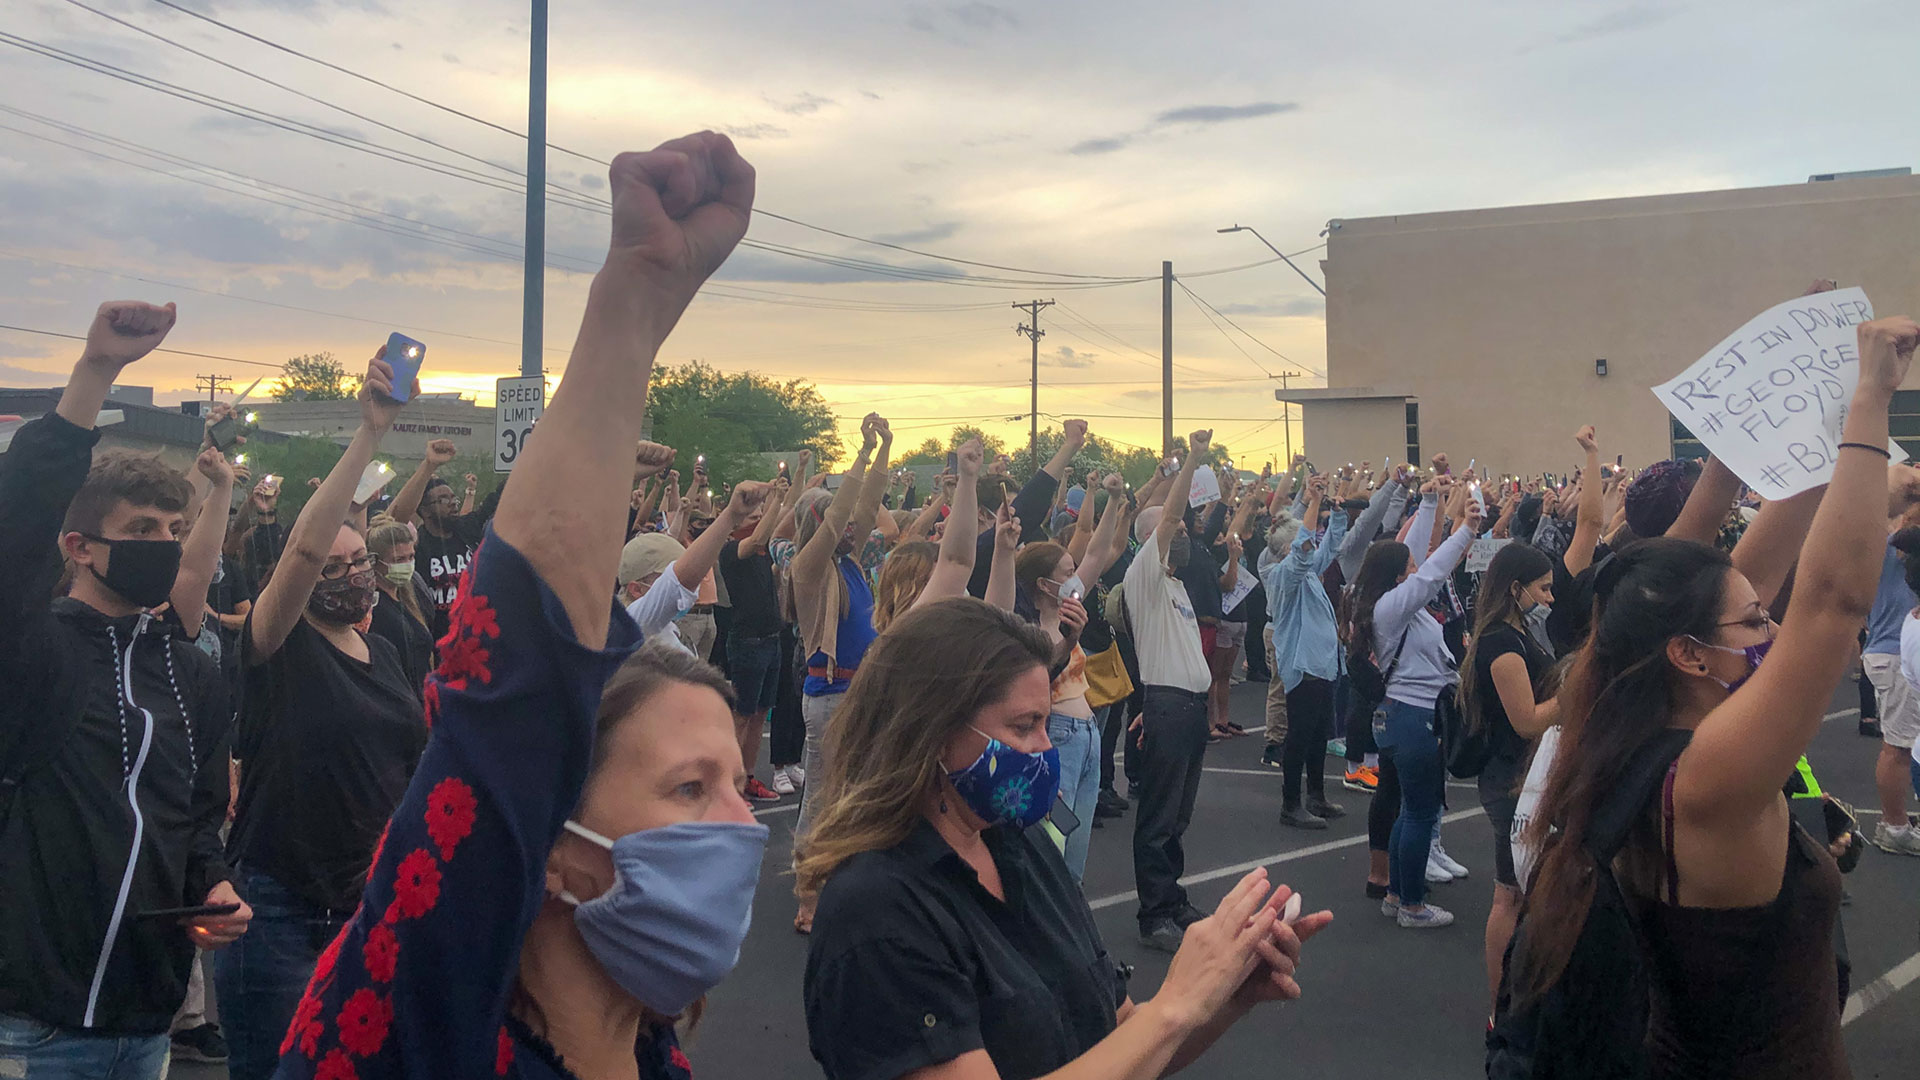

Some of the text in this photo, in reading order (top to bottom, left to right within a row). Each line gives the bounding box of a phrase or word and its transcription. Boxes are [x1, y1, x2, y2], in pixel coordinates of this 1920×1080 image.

[1671, 300, 1873, 411] REST IN POWER
[500, 388, 541, 403] SPEED
[1700, 343, 1859, 436] #GEORGE
[418, 424, 442, 434] FAMILY
[444, 425, 472, 436] KITCHEN
[504, 407, 535, 423] LIMIT
[1739, 379, 1845, 443] FLOYD
